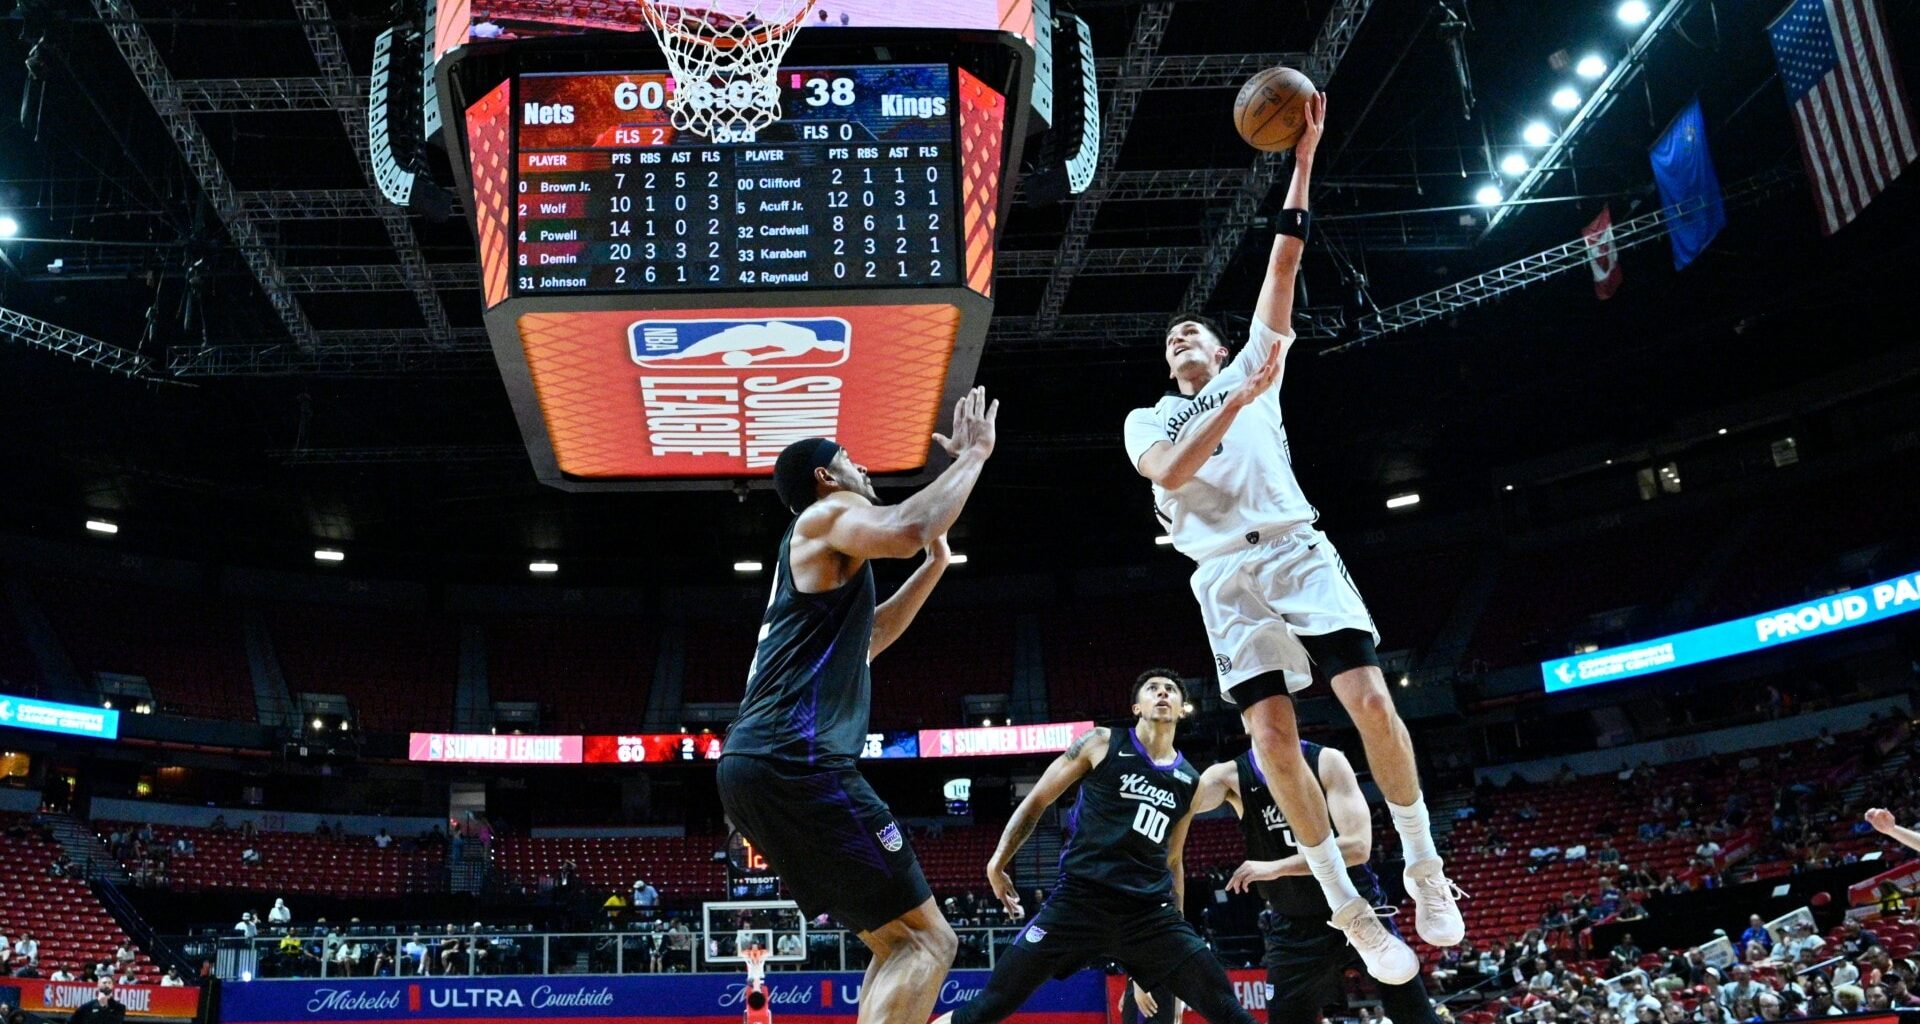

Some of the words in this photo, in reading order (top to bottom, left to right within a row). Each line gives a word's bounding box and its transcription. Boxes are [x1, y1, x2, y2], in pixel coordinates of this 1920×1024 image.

[614, 82, 663, 110] 60
[806, 78, 855, 106] 38
[525, 103, 574, 124] Nets
[882, 95, 946, 119] Kings
[616, 130, 640, 143] FLS
[652, 128, 663, 144] 2
[804, 125, 828, 139] FLS
[840, 124, 852, 140] 0
[529, 155, 566, 166] PLAYER
[612, 154, 631, 164] PTS
[641, 153, 660, 163] RBS
[672, 152, 691, 162] AST
[702, 151, 720, 162] FLS
[746, 150, 783, 161] PLAYER
[829, 148, 848, 159] PTS
[858, 148, 878, 158] RBS
[889, 147, 908, 157] AST
[920, 147, 937, 157] FLS
[519, 181, 527, 192] 0
[541, 182, 575, 192] Brown
[579, 182, 590, 191] Jr.
[615, 174, 625, 189] 7
[645, 173, 655, 188] 2
[676, 172, 685, 187] 5
[708, 172, 718, 187] 2
[738, 179, 753, 190] 00
[760, 178, 800, 188] Clifford
[832, 169, 842, 184] 2
[864, 168, 872, 183] 1
[895, 168, 904, 183] 1
[927, 167, 937, 182] 0
[519, 204, 526, 215] 2
[541, 203, 566, 213] Wolf
[611, 196, 630, 212] 10
[646, 196, 655, 211] 1
[676, 195, 686, 210] 0
[709, 195, 718, 210] 3
[738, 202, 745, 214] 5
[760, 201, 789, 211] Acuff
[792, 201, 803, 210] Jr.
[828, 191, 848, 207] 12
[863, 191, 873, 206] 0
[895, 190, 905, 205] 3
[929, 190, 938, 205] 1
[519, 231, 526, 242] 4
[541, 230, 576, 240] Powell
[611, 221, 630, 236] 14
[647, 220, 655, 235] 1
[676, 220, 686, 235] 0
[709, 219, 718, 234] 2
[738, 227, 753, 238] 32
[760, 225, 808, 235] Cardwell
[833, 216, 843, 231] 8
[864, 215, 874, 230] 6
[897, 215, 905, 230] 1
[929, 214, 938, 229] 2
[519, 254, 527, 265] 8
[541, 254, 576, 264] Demin
[610, 244, 630, 259] 20
[646, 243, 655, 259] 3
[676, 243, 686, 258] 3
[709, 242, 719, 257] 2
[739, 250, 753, 261] 33
[761, 249, 806, 259] Karaban
[834, 239, 844, 255] 2
[865, 238, 875, 254] 3
[897, 238, 906, 253] 2
[931, 237, 939, 252] 1
[520, 277, 534, 289] 31
[540, 277, 586, 287] Johnson
[615, 267, 625, 283] 2
[646, 266, 655, 282] 6
[678, 266, 686, 281] 1
[710, 265, 719, 281] 2
[739, 271, 755, 282] 42
[762, 271, 808, 284] Raynaud
[835, 262, 845, 278] 0
[866, 262, 875, 277] 2
[898, 261, 907, 276] 1
[931, 260, 940, 276] 2
[643, 328, 679, 351] NBA
[640, 376, 741, 456] LEAGUE
[1755, 595, 1868, 642] PROUD
[445, 735, 507, 760] SUMMER
[511, 737, 562, 760] LEAGUE
[682, 738, 694, 752] 2
[955, 728, 1017, 750] SUMMER
[1021, 725, 1074, 749] LEAGUE
[618, 745, 645, 762] 60
[1119, 773, 1176, 809] Kings
[1132, 802, 1170, 844] 00
[744, 876, 774, 884] TISSOT
[56, 985, 98, 1007] SUMME
[114, 990, 151, 1012] EAGUE
[307, 989, 400, 1012] Michelob
[430, 989, 523, 1008] ULTRA
[531, 985, 614, 1009] Courtside
